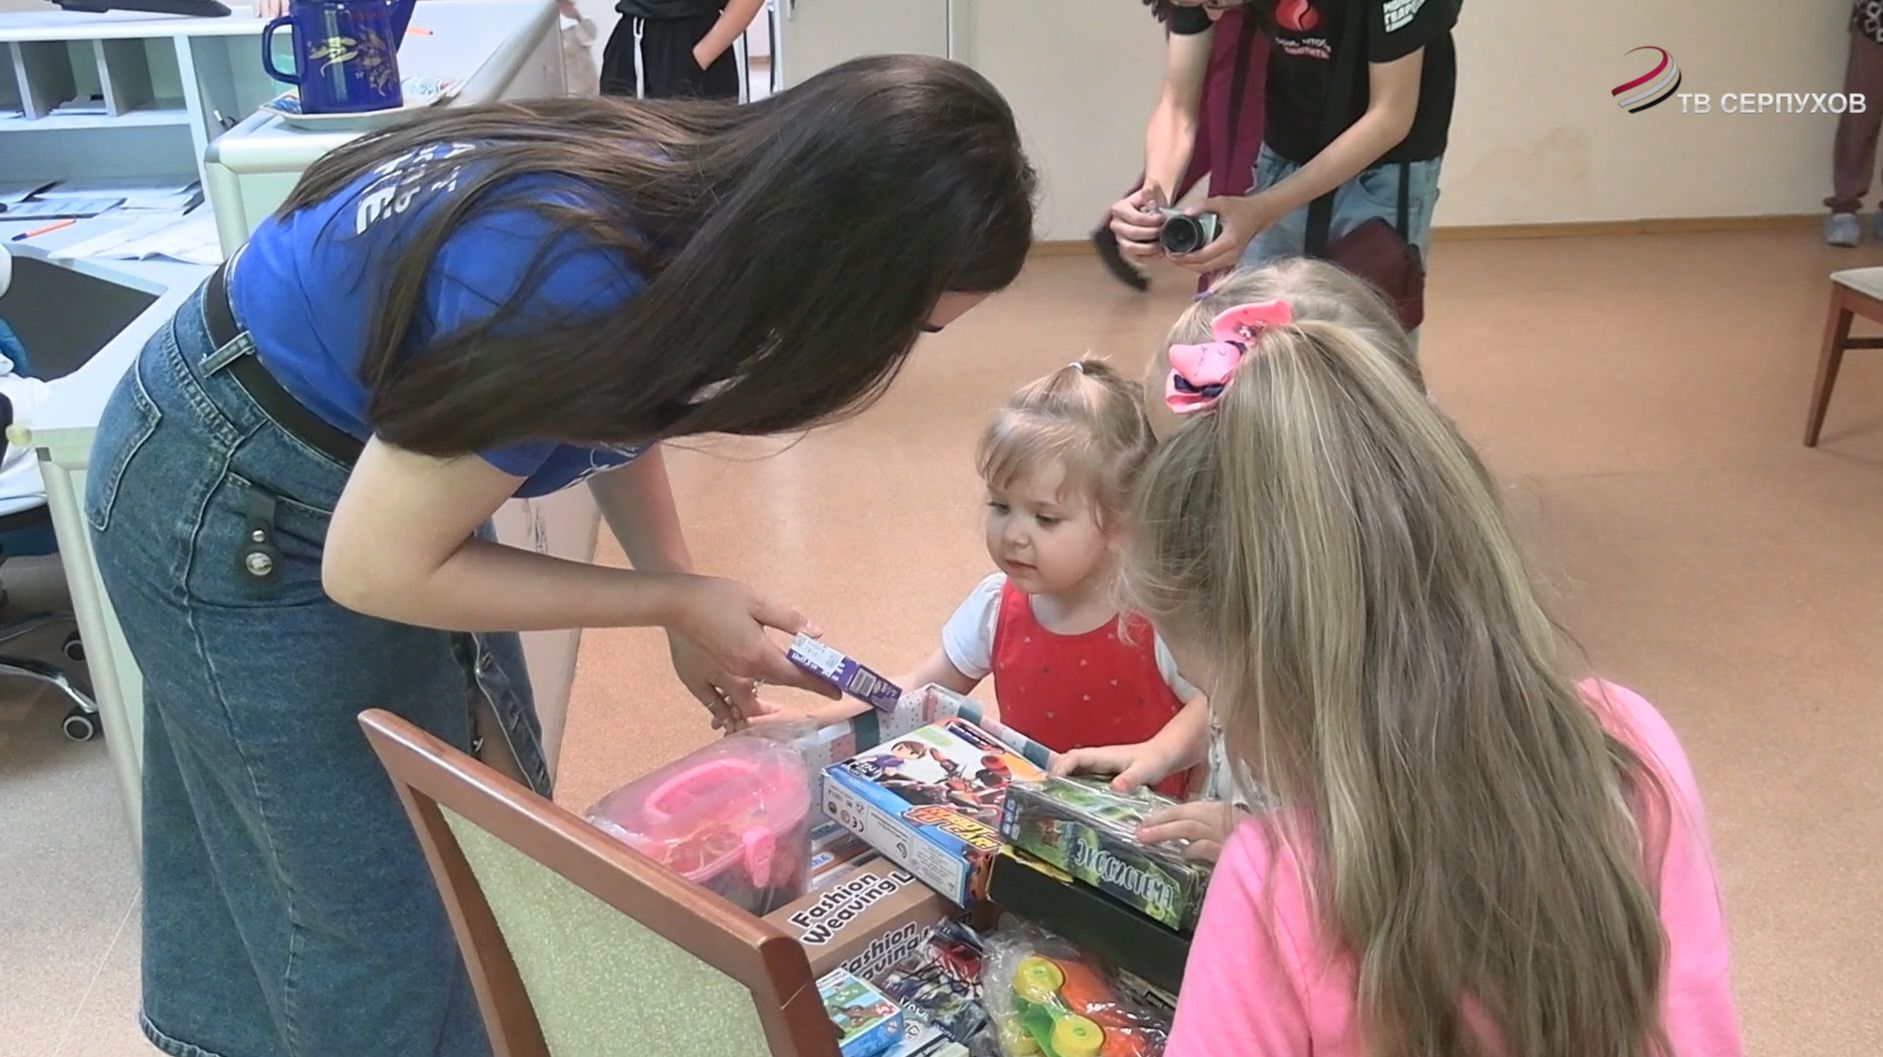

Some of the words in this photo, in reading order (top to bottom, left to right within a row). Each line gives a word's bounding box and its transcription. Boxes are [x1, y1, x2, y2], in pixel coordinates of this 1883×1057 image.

[789, 872, 880, 929] Fashion
[1073, 837, 1174, 907] ЭКОСИСТЕМА
[801, 878, 898, 945] Weaving
[860, 935, 920, 981] aving
